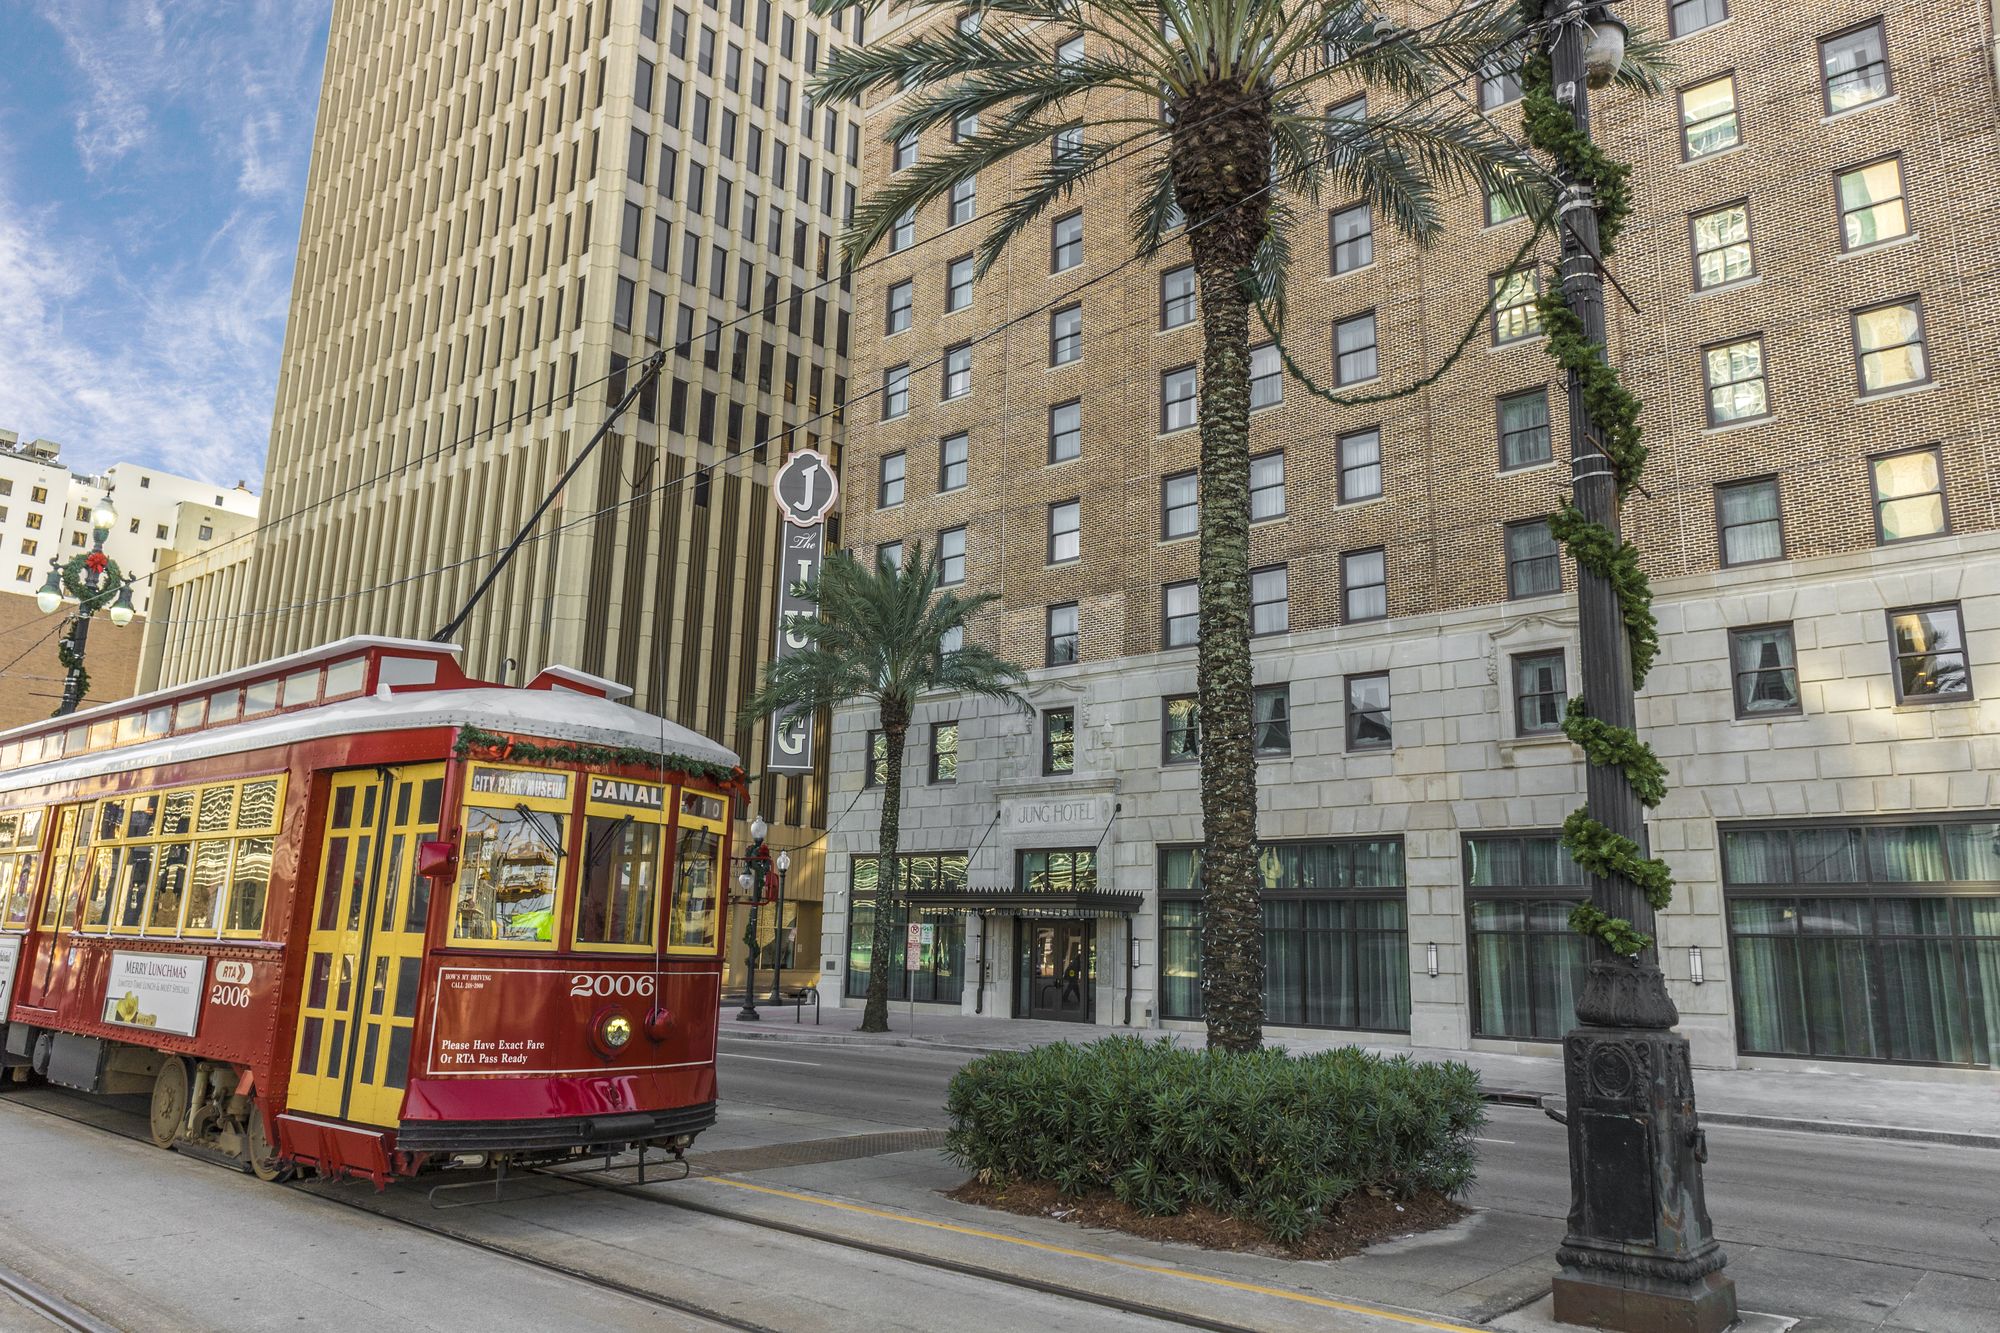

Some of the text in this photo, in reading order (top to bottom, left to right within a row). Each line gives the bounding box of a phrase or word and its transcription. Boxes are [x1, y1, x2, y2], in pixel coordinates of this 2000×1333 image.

[793, 463, 819, 512] J
[789, 532, 817, 550] The
[777, 559, 814, 755] JUG
[473, 775, 566, 799] CITY PARK MUSEUM
[591, 778, 661, 805] CANAL
[1018, 803, 1095, 824] JUNG HOTEL
[125, 960, 188, 979] MERRY LUNCHMAS
[222, 965, 237, 979] RTA
[210, 984, 250, 1008] 2006
[570, 974, 655, 997] 2006
[441, 1039, 545, 1050] Please Have Exact Fare
[440, 1053, 528, 1065] Or RTA Pass Ready
